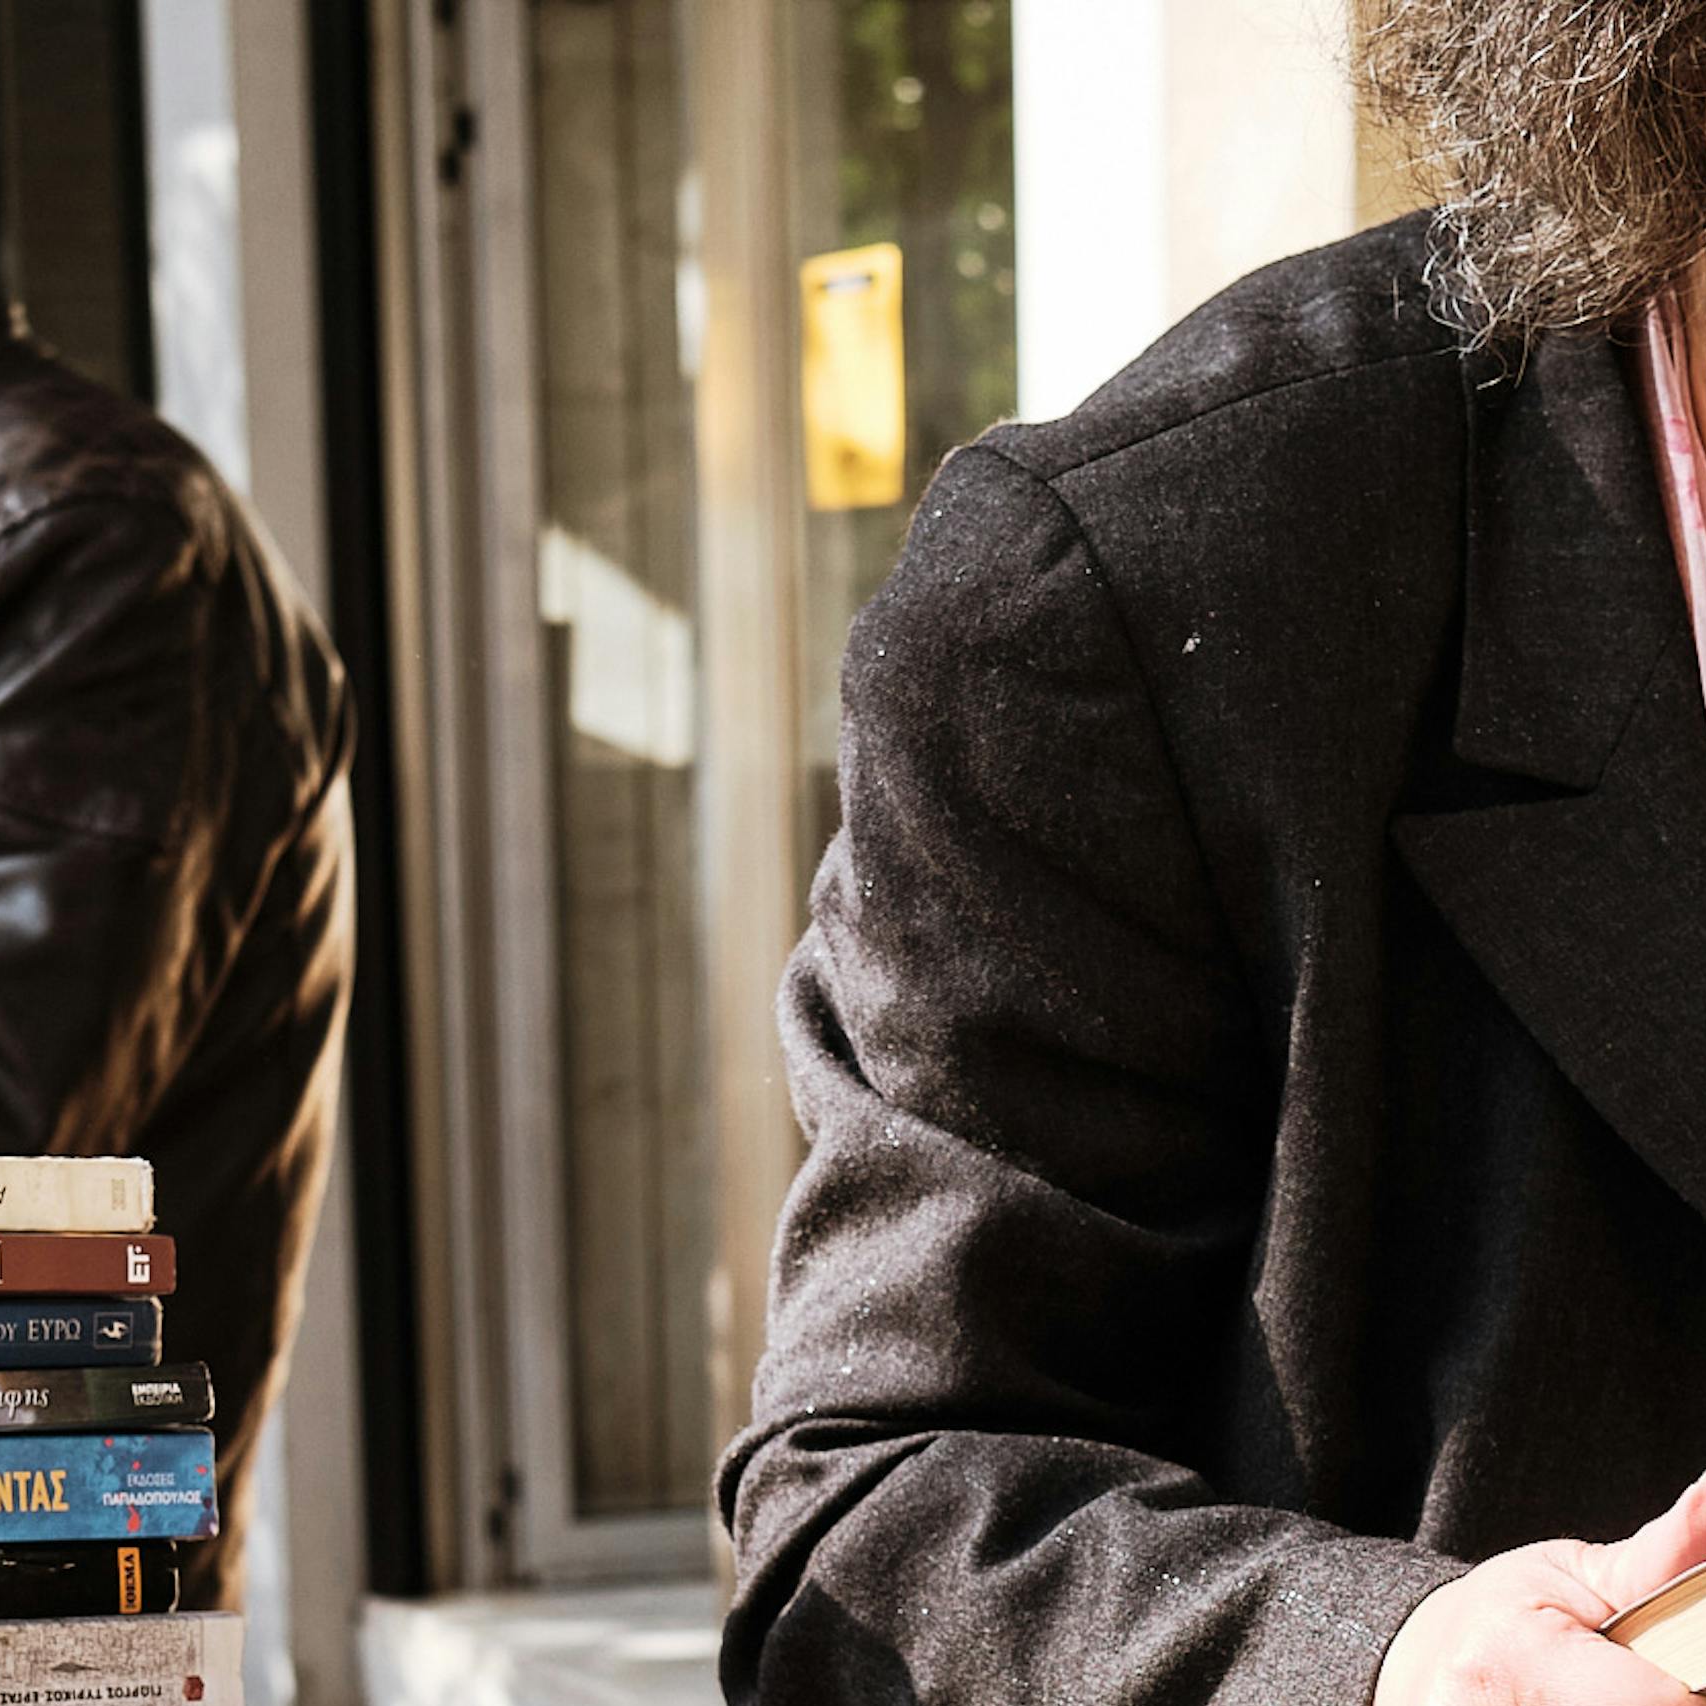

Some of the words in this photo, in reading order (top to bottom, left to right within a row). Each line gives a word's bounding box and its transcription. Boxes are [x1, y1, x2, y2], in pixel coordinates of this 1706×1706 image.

[28, 1319, 82, 1341] ΕΥΡΩ
[102, 1490, 203, 1507] ΠΑΠΑΔΟΠΟΥΛΟΣ
[107, 1685, 163, 1699] ΓΙΩΡΓΟΣ
